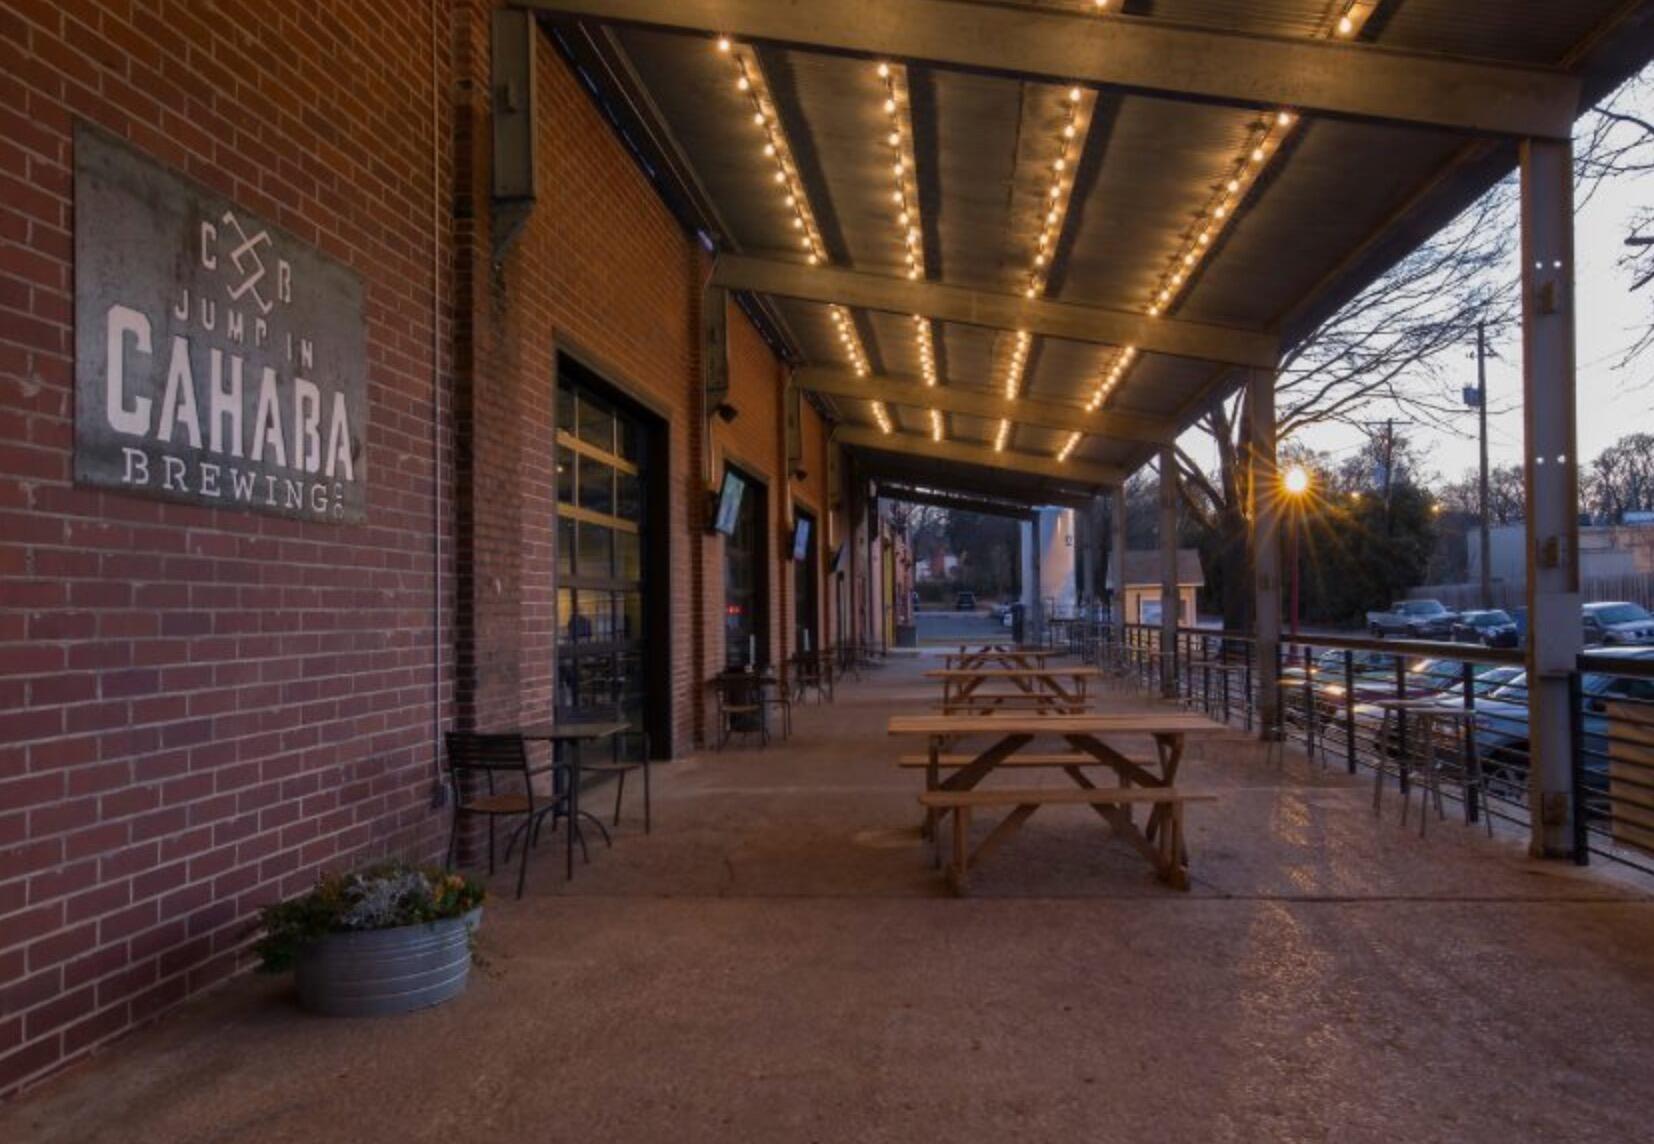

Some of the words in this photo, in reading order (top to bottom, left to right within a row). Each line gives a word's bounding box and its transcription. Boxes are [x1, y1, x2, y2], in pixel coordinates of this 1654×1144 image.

[201, 221, 217, 270] C
[174, 289, 267, 346] JUMP
[287, 332, 313, 369] IN
[107, 304, 353, 480] CAHABA
[122, 447, 328, 512] BREWING
